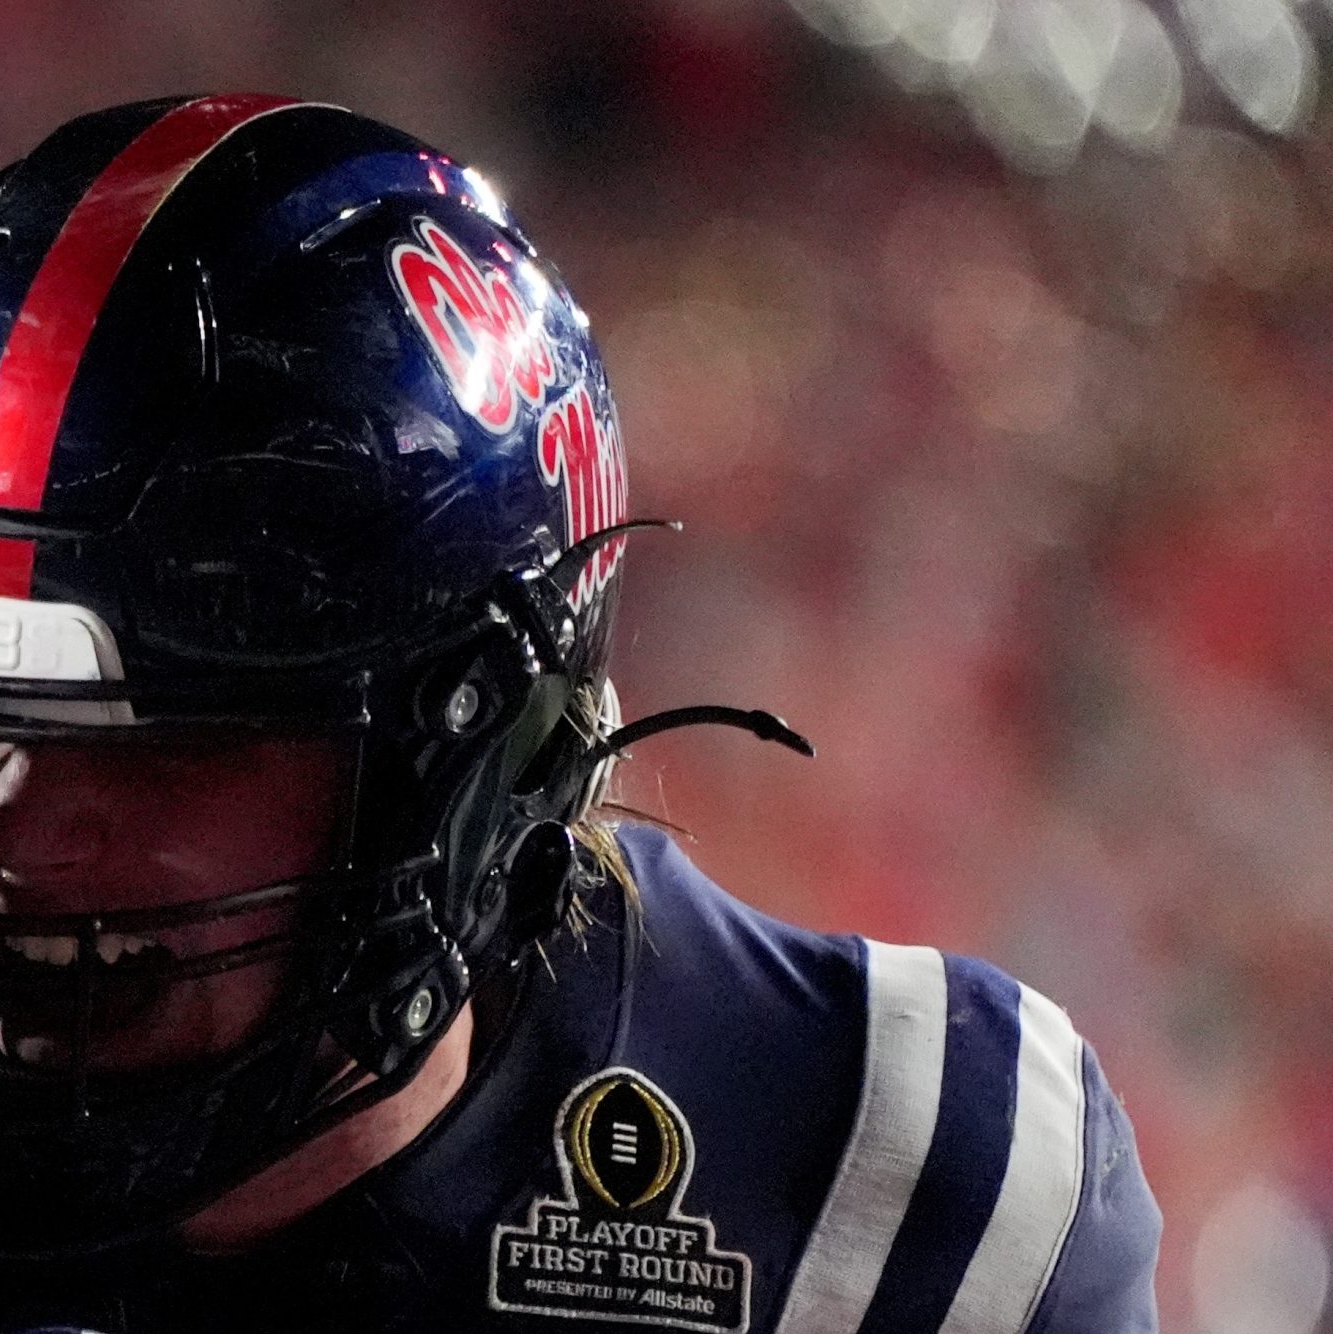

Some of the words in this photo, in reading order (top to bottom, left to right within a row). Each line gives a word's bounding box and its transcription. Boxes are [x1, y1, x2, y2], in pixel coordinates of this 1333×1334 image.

[545, 1214, 699, 1255] PLAYOFF
[506, 1240, 610, 1276] FIRST
[618, 1252, 734, 1291] ROUND
[524, 1278, 614, 1301] PRESENTED
[616, 1286, 637, 1302] BY
[638, 1287, 716, 1316] Allstate
